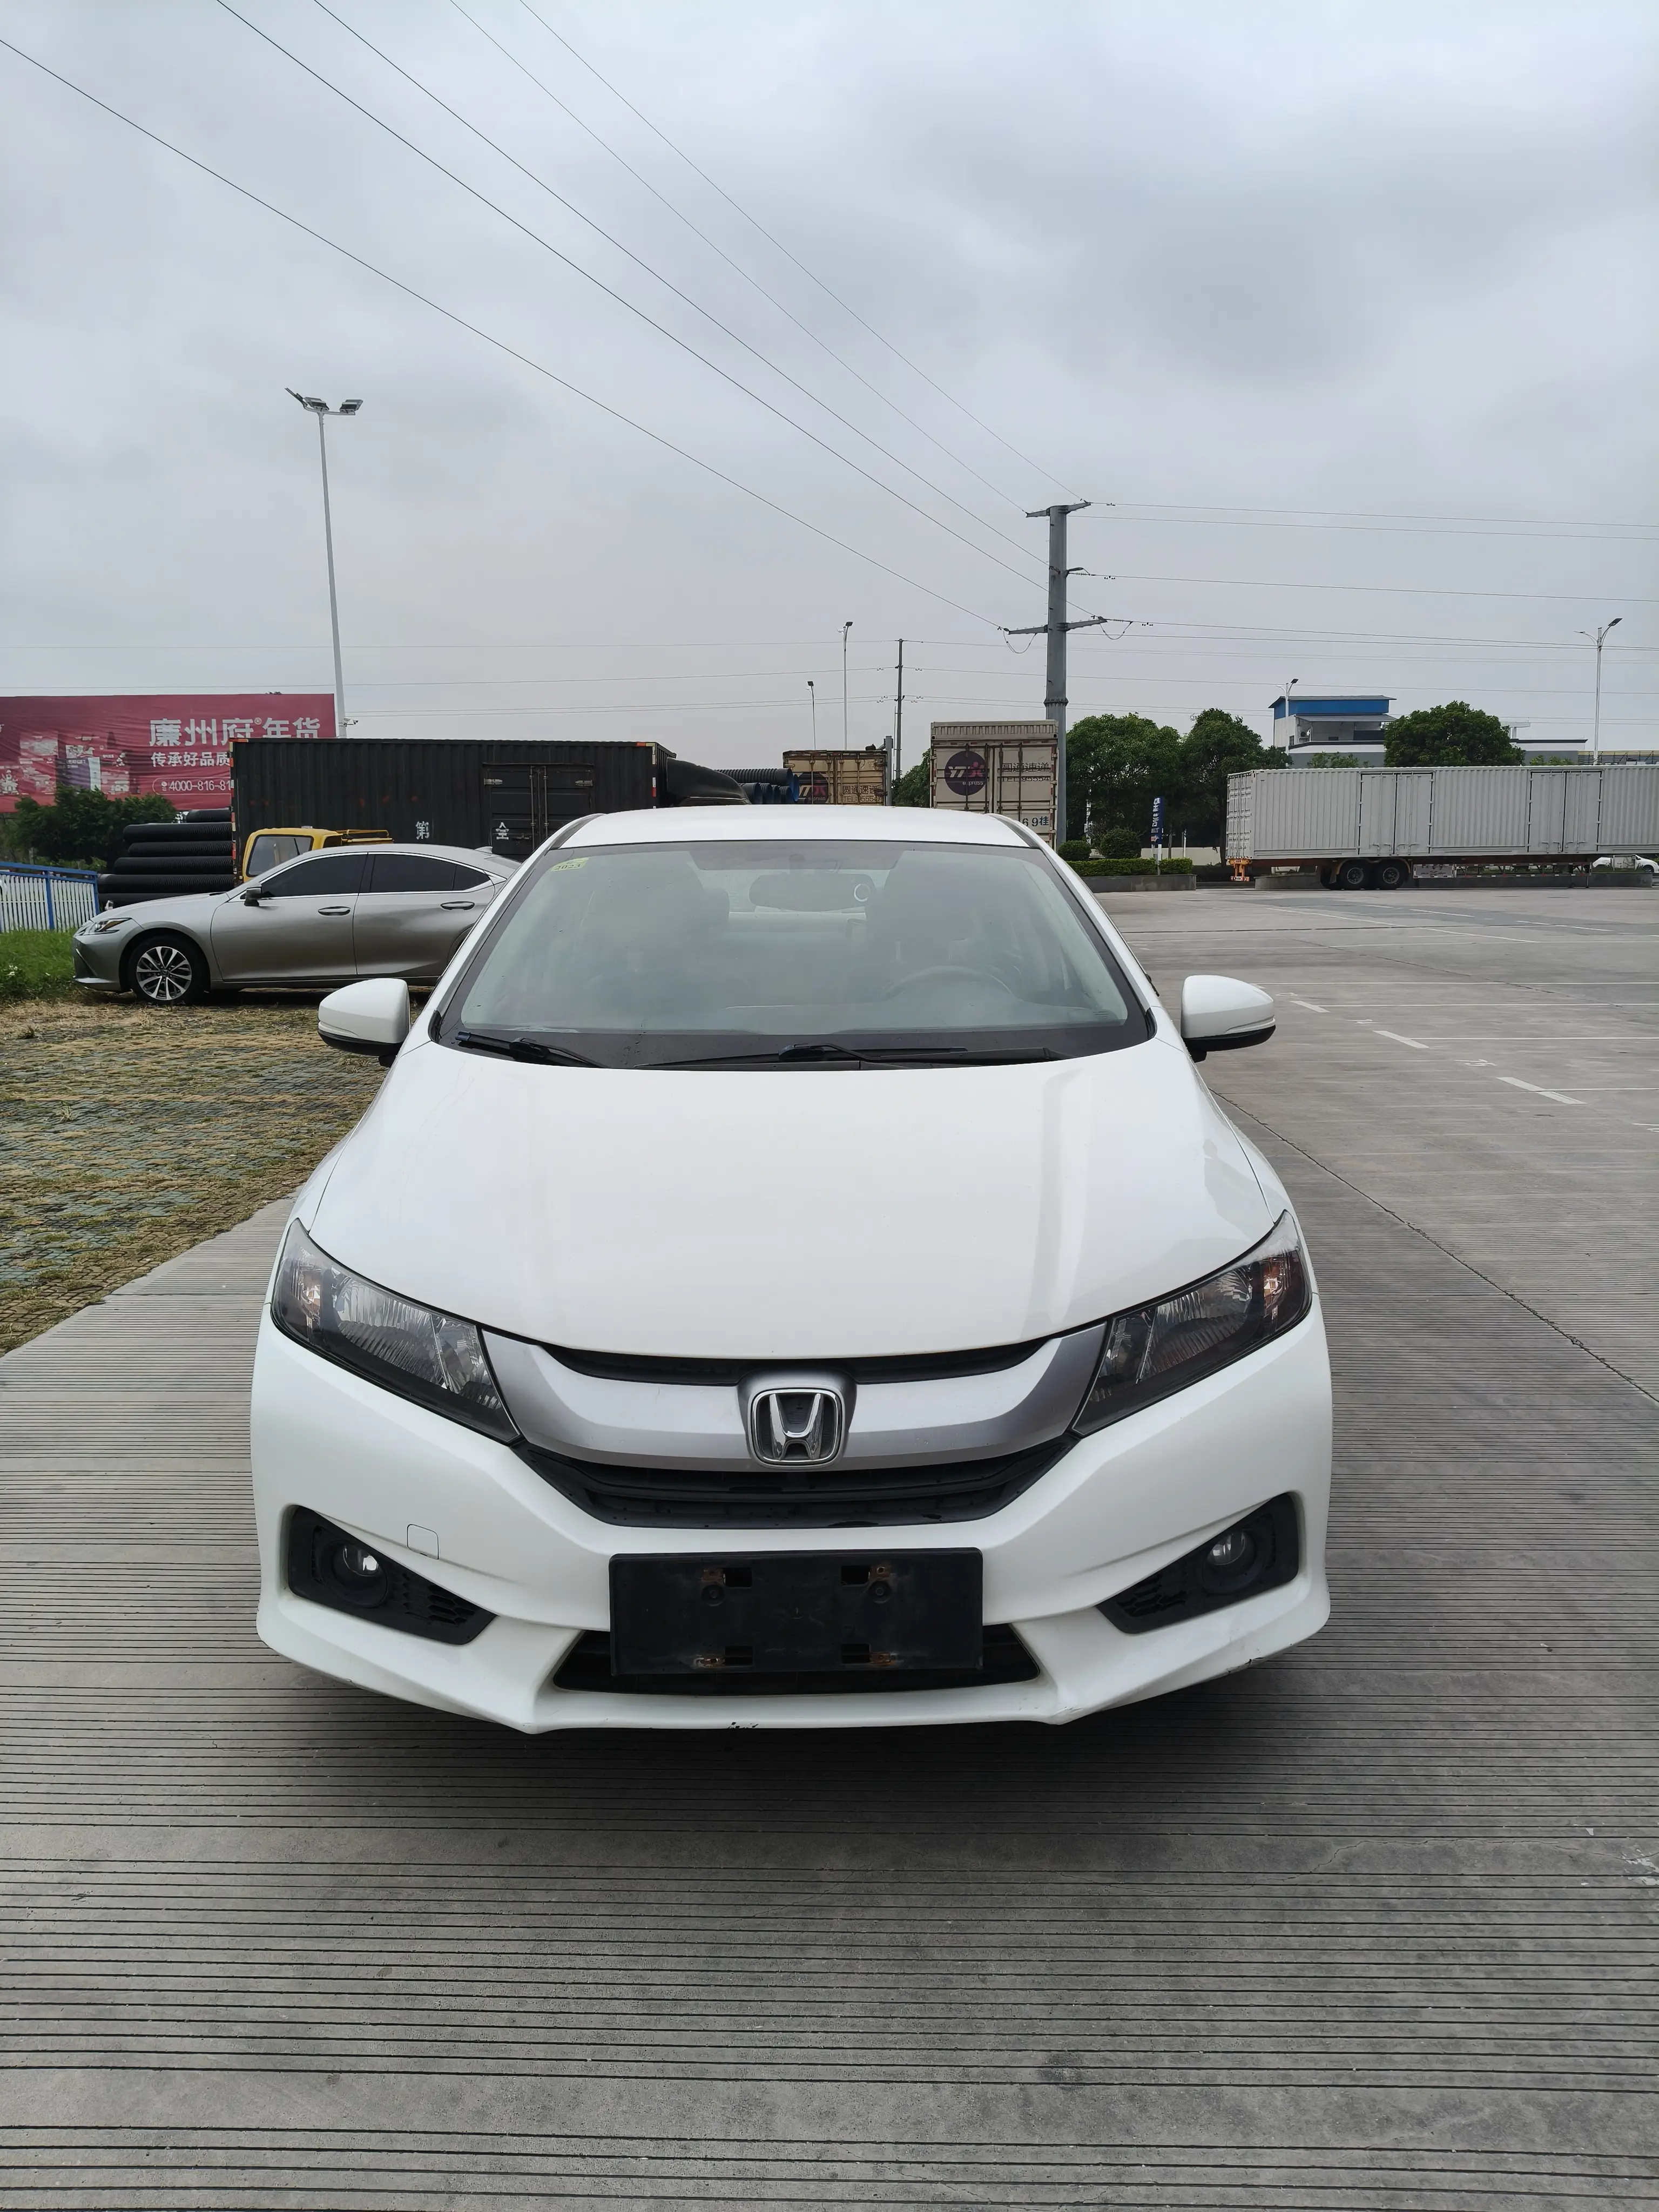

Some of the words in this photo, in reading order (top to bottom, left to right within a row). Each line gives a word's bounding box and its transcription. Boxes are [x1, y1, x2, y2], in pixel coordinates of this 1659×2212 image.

[151, 751, 230, 767] 传承好品质
[415, 821, 430, 840] 第
[495, 822, 509, 840] 全
